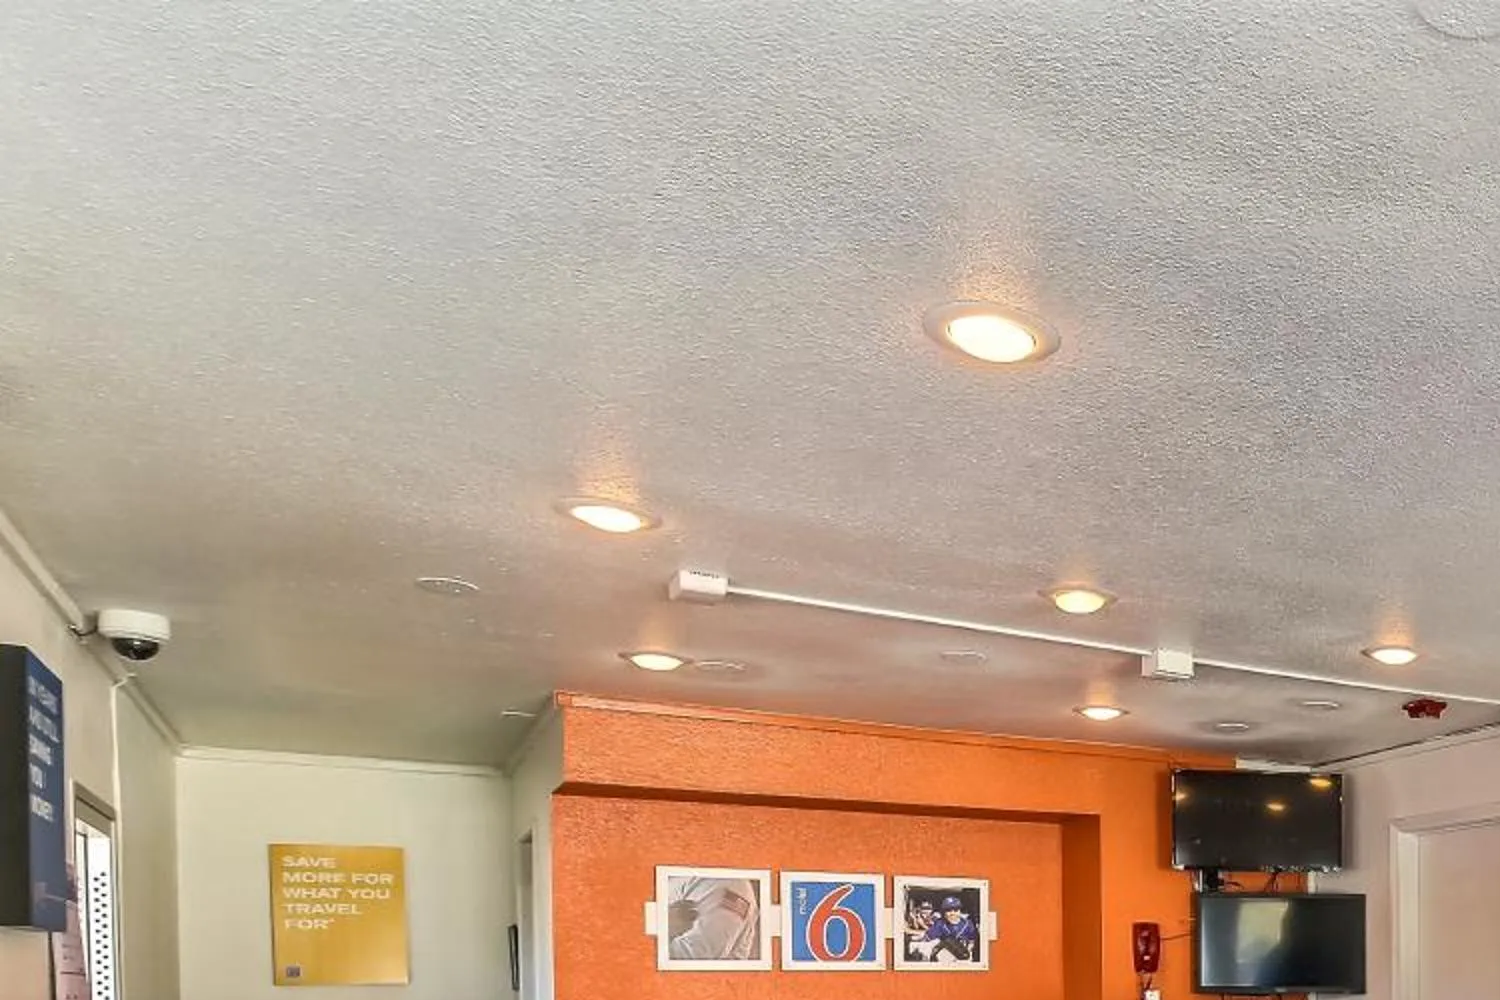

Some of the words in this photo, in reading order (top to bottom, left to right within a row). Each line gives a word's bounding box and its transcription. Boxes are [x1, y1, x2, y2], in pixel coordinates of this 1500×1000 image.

[282, 857, 337, 869] SAVE
[282, 872, 347, 884] MORE
[351, 873, 395, 885] FOR
[282, 887, 342, 899] WHAT
[347, 888, 391, 900] YOU
[284, 903, 363, 915] TRAVEL
[806, 884, 867, 962] 6
